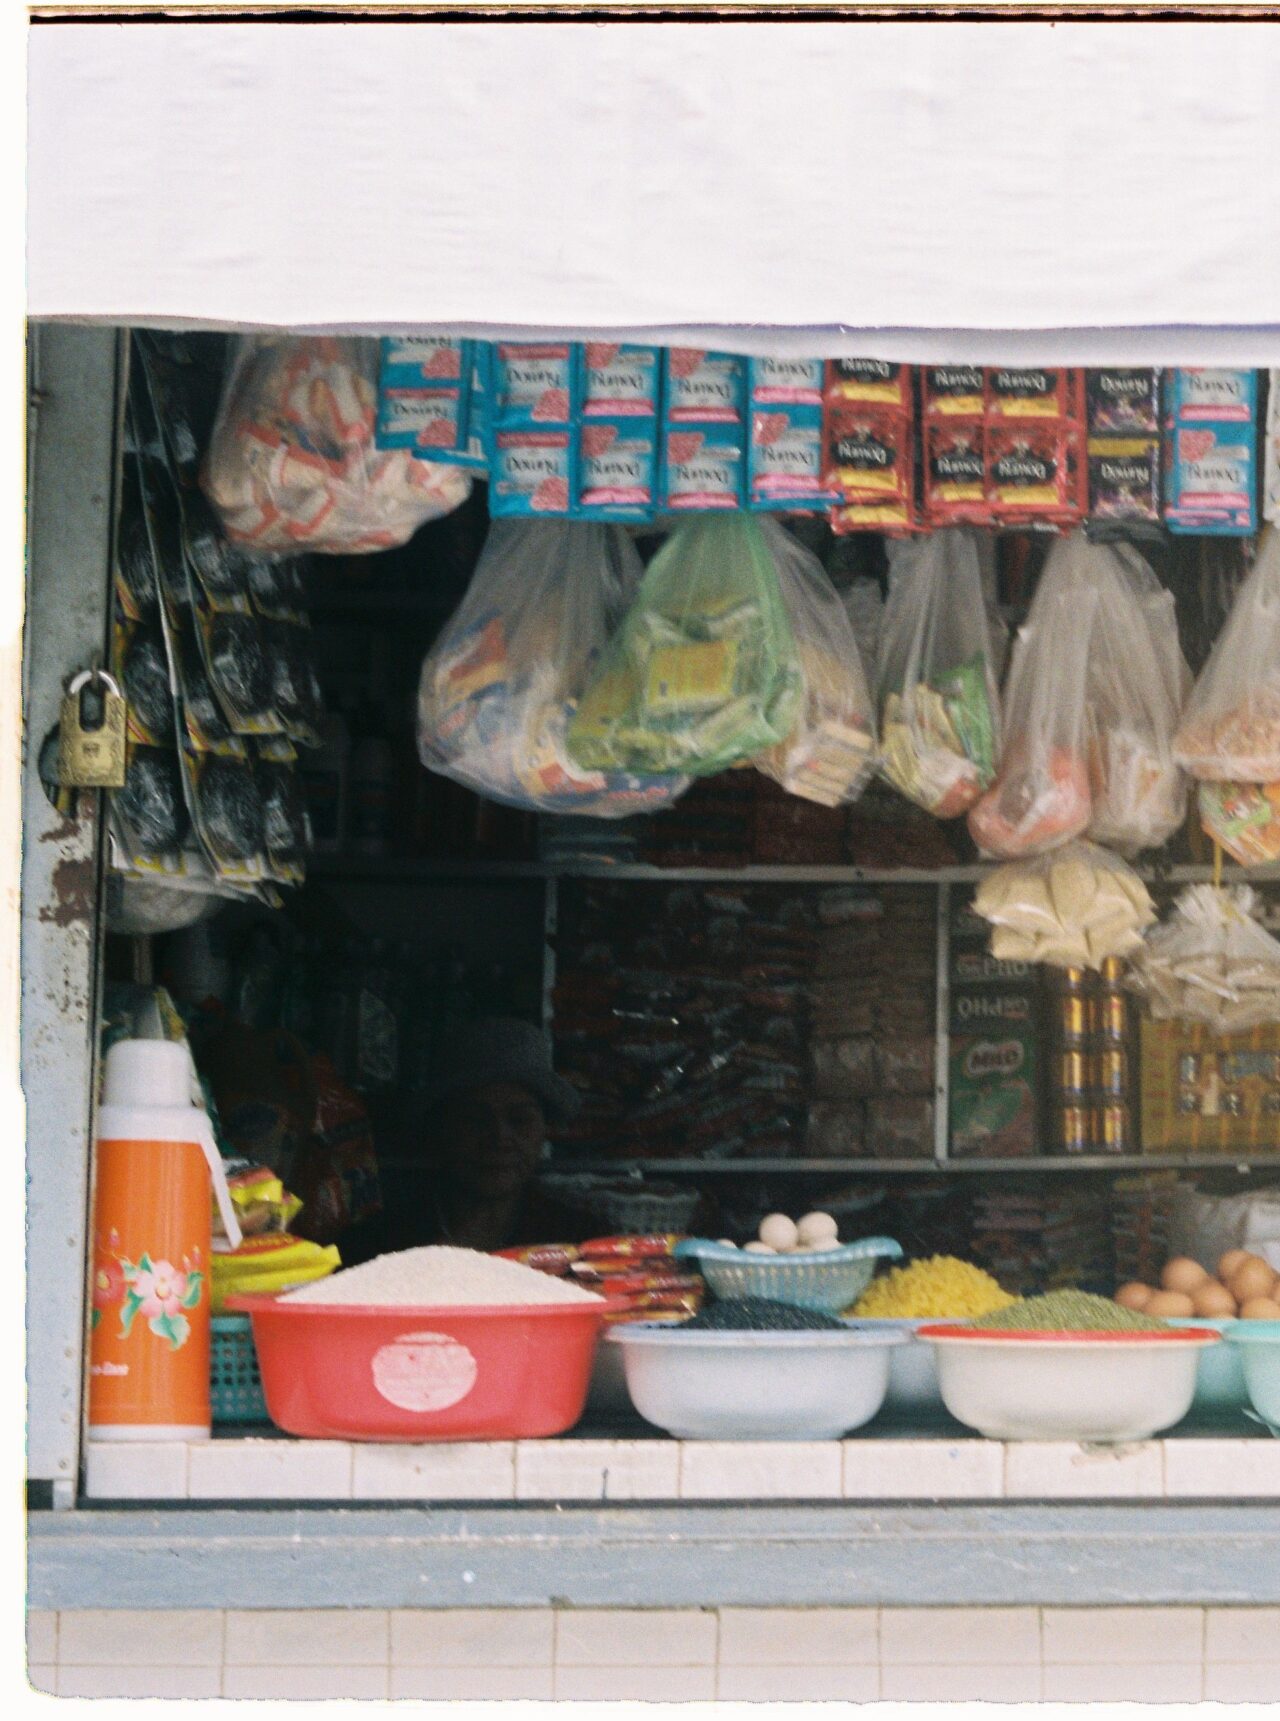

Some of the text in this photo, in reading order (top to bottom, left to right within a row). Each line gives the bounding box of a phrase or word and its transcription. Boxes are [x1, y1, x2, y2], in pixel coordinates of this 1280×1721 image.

[508, 369, 560, 386] Downy
[762, 359, 813, 377] Downy
[591, 373, 643, 390] Downy
[678, 380, 731, 399] Downy
[935, 370, 983, 392] Downy
[998, 371, 1047, 392] Downy
[1101, 375, 1149, 396] Downy
[1189, 376, 1239, 396] Downy
[394, 404, 447, 417] Downy
[762, 448, 813, 465] Downy
[838, 442, 887, 464] Downy
[506, 456, 559, 472] Downy
[590, 459, 640, 476] Downy
[999, 457, 1046, 480] Downy
[1101, 463, 1150, 484] Downy
[1187, 464, 1239, 483] Downy
[676, 465, 728, 483] Downy
